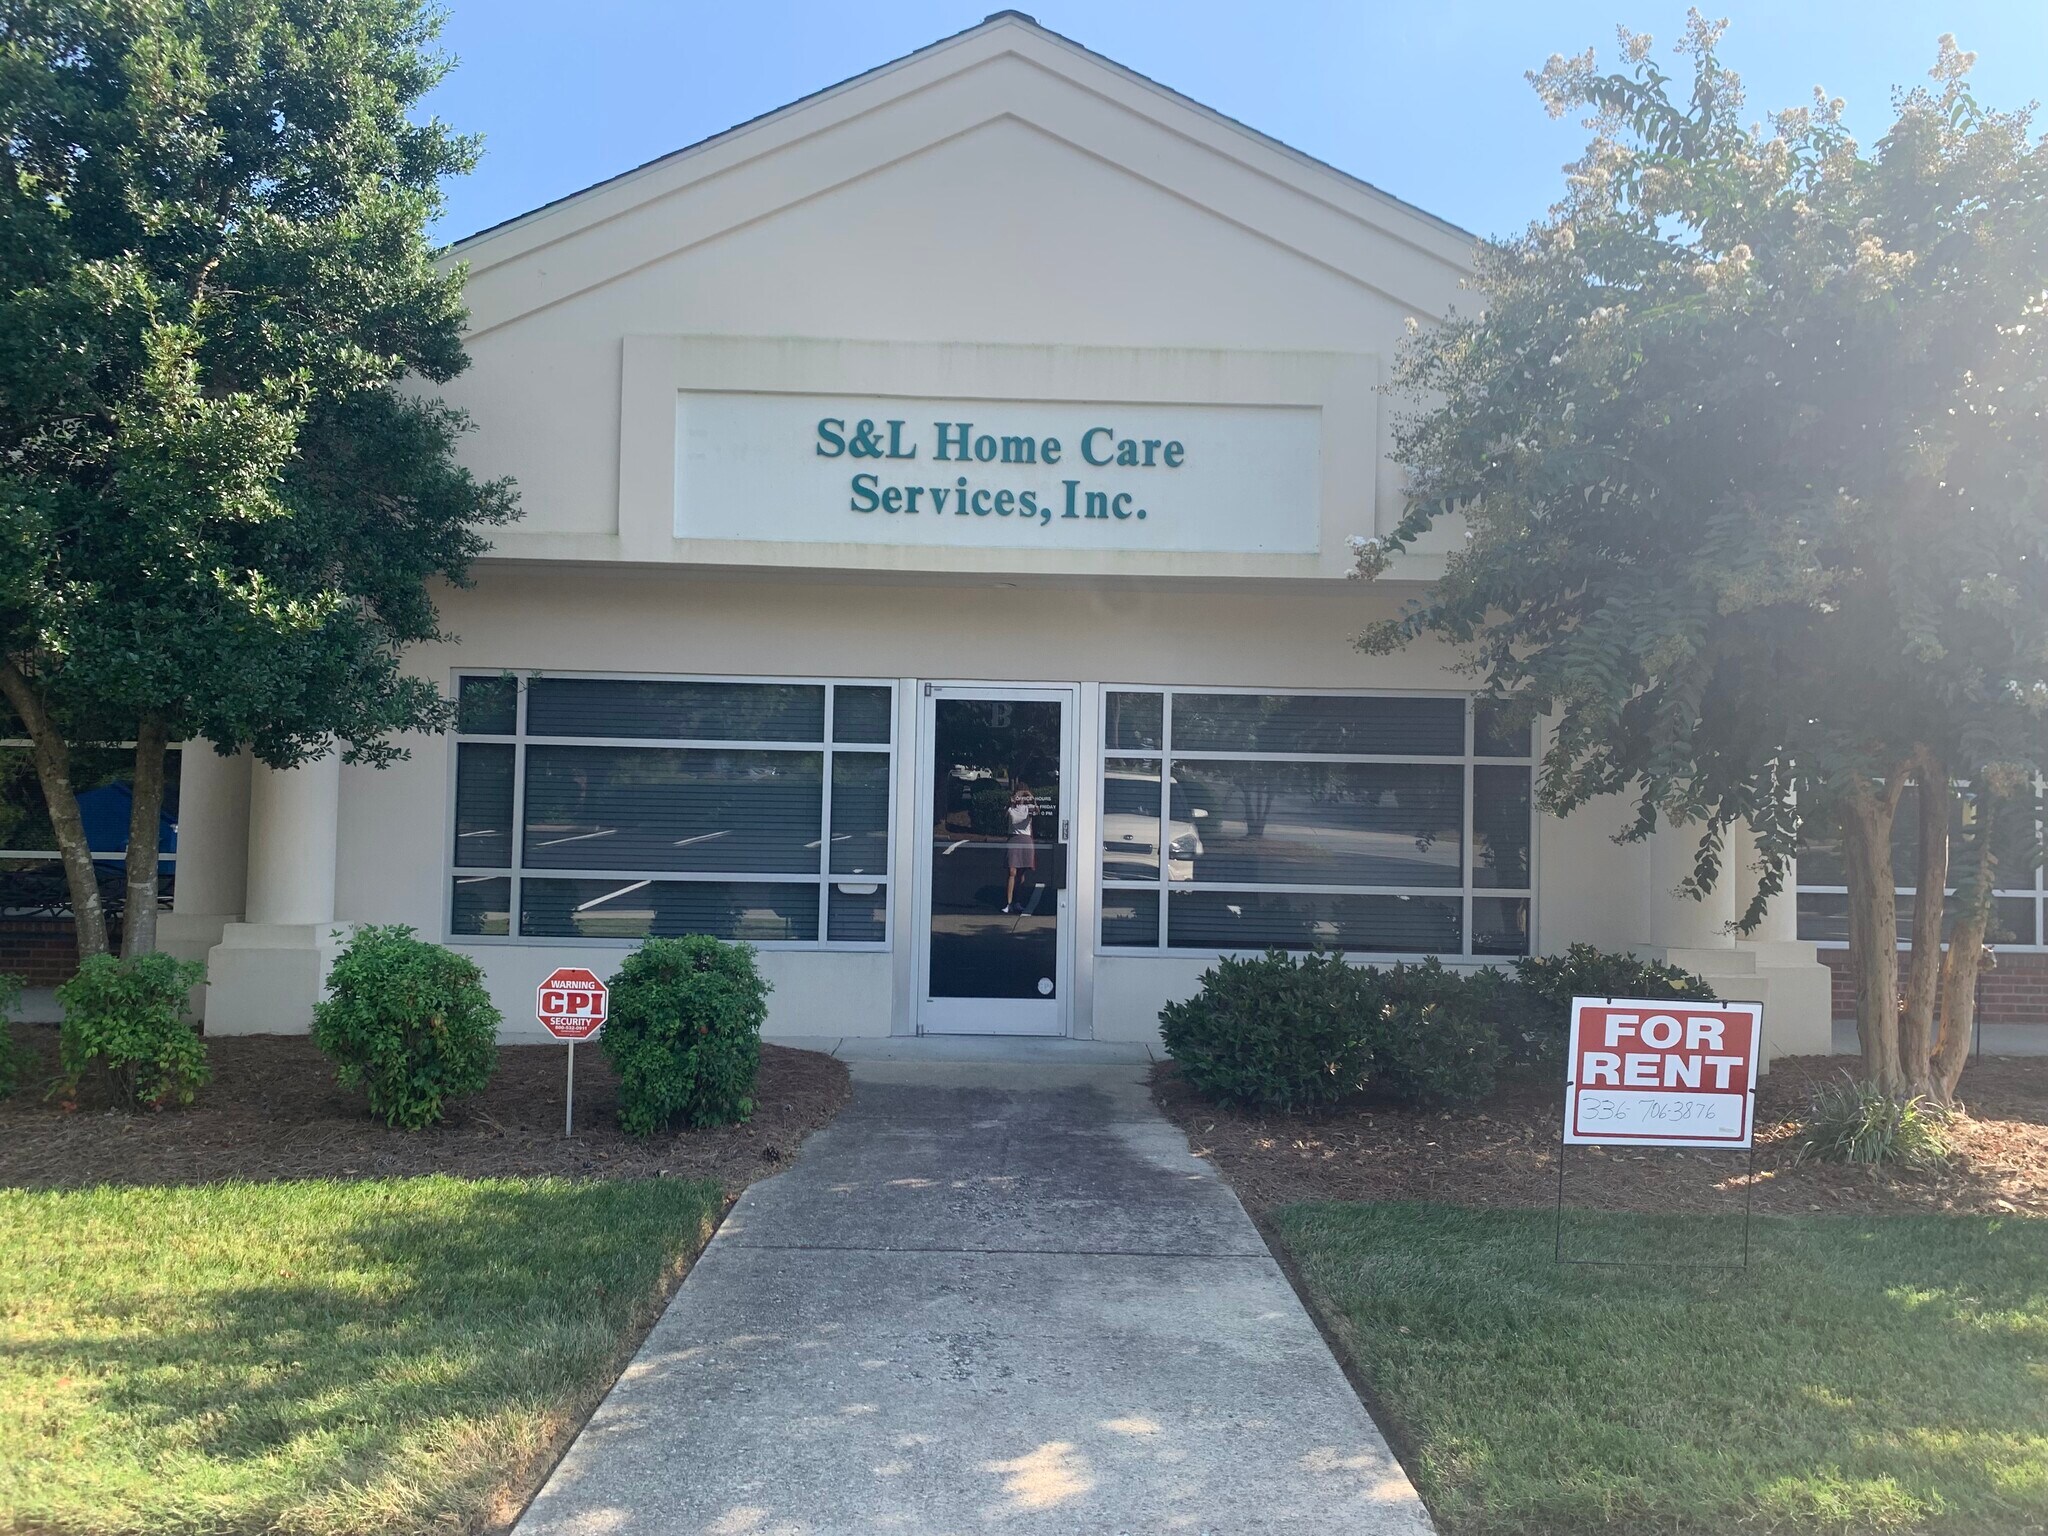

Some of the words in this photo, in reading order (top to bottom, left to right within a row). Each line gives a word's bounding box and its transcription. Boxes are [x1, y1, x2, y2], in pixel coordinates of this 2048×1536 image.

[816, 417, 917, 459] S&L
[933, 421, 1062, 465] Home
[1081, 426, 1185, 468] Care
[850, 473, 1052, 527] Services,
[1061, 479, 1147, 520] Inc.
[542, 991, 603, 1015] CPI
[550, 980, 595, 989] WARNING
[550, 1017, 592, 1026] SECURITY
[1604, 1014, 1725, 1051] FOR
[1582, 1051, 1744, 1089] RENT
